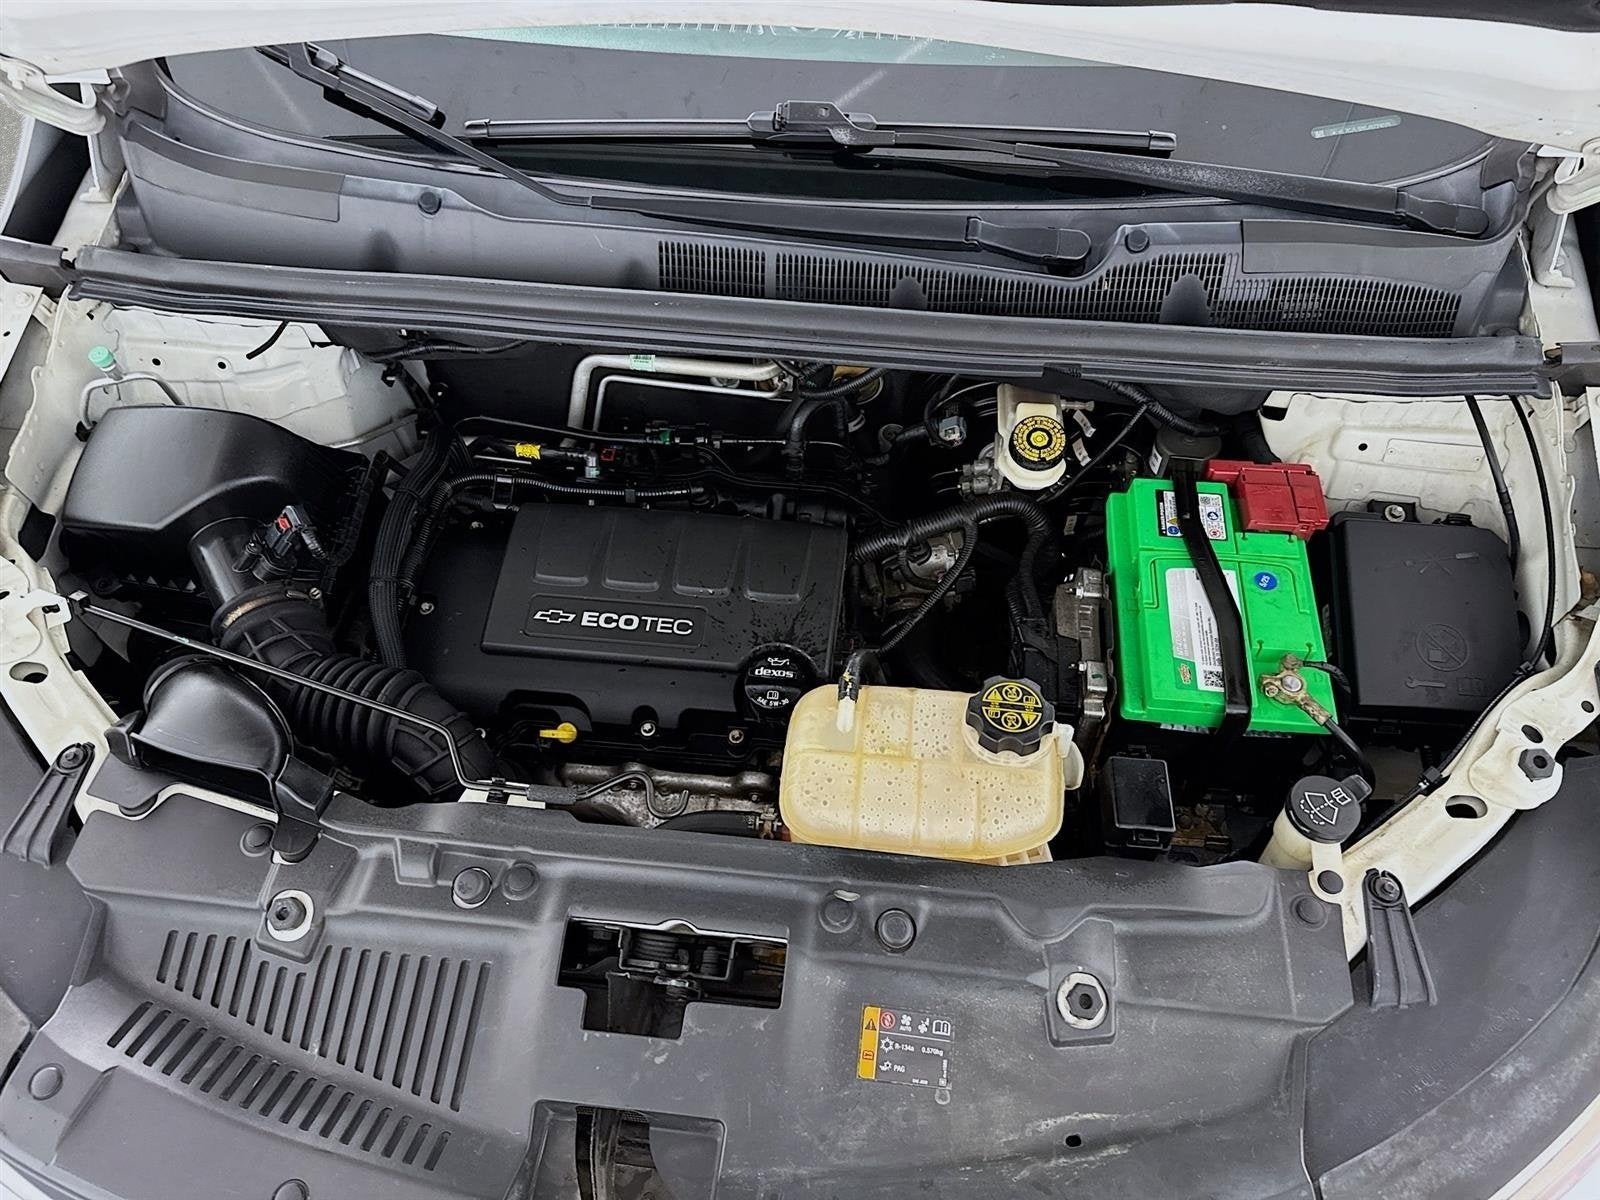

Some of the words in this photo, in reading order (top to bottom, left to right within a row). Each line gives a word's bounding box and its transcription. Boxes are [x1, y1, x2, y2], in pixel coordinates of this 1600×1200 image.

[581, 611, 694, 635] ECOTEC
[755, 667, 794, 678] dexos
[894, 1043, 915, 1052] R-134a
[893, 1064, 905, 1073] PAG
